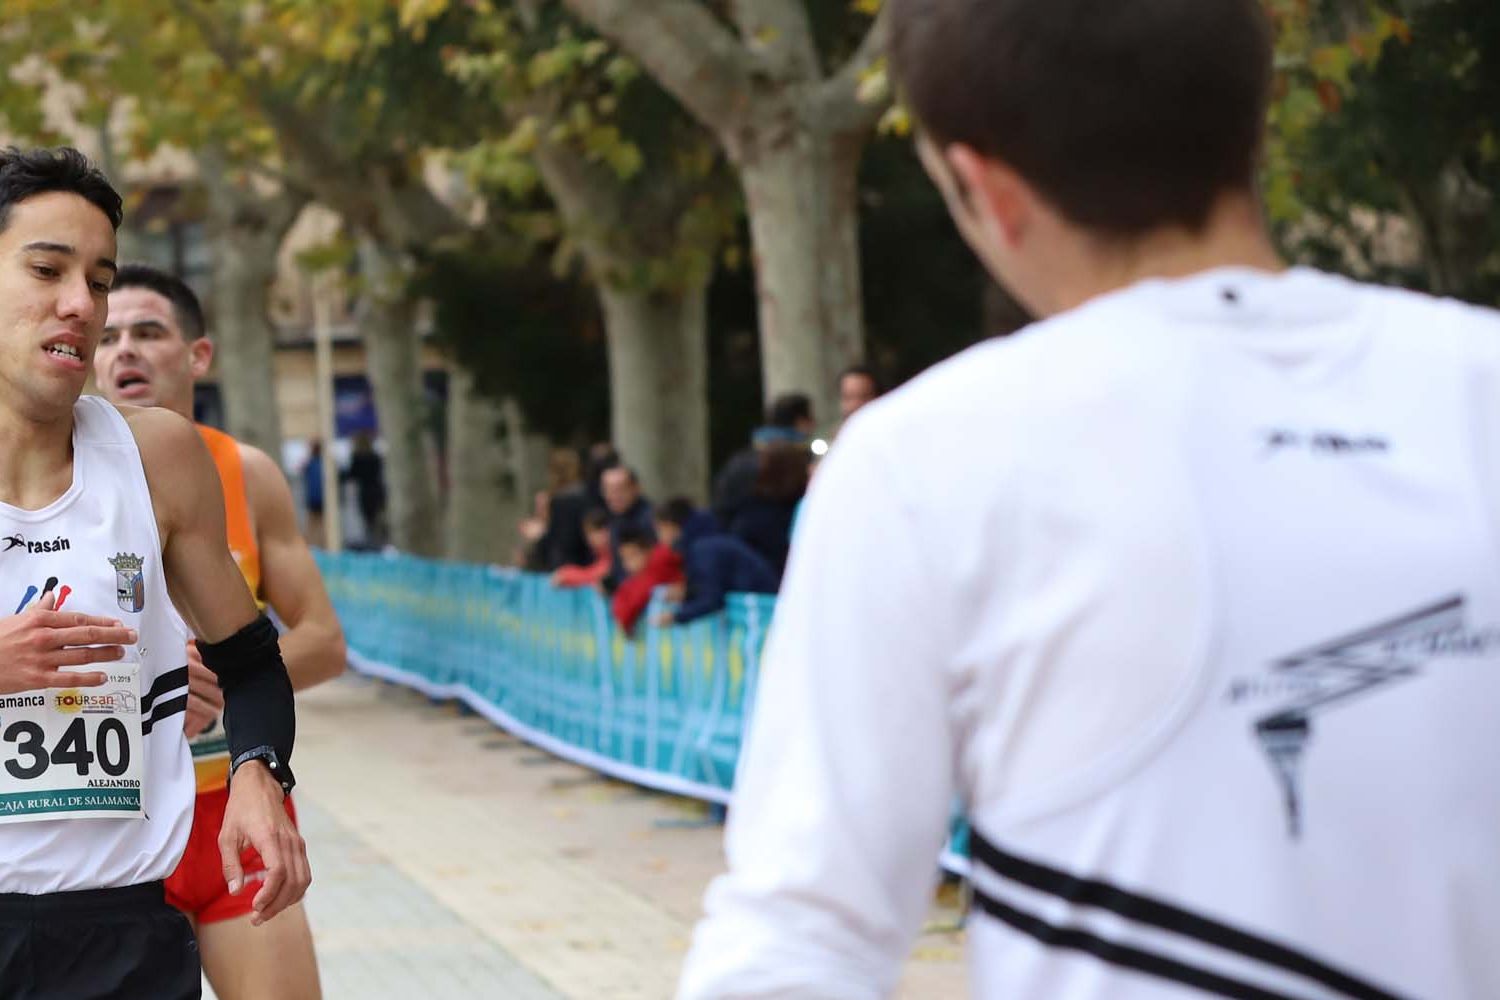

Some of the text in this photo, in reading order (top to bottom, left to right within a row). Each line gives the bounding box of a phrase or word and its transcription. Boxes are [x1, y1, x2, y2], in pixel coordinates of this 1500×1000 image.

[27, 535, 71, 553] rasán
[55, 695, 114, 706] TOURsan
[3, 717, 131, 780] 340
[87, 779, 141, 788] ALEJANDRO
[27, 798, 65, 809] RURAL
[68, 796, 83, 806] DE
[84, 796, 141, 806] SALAMANCA
